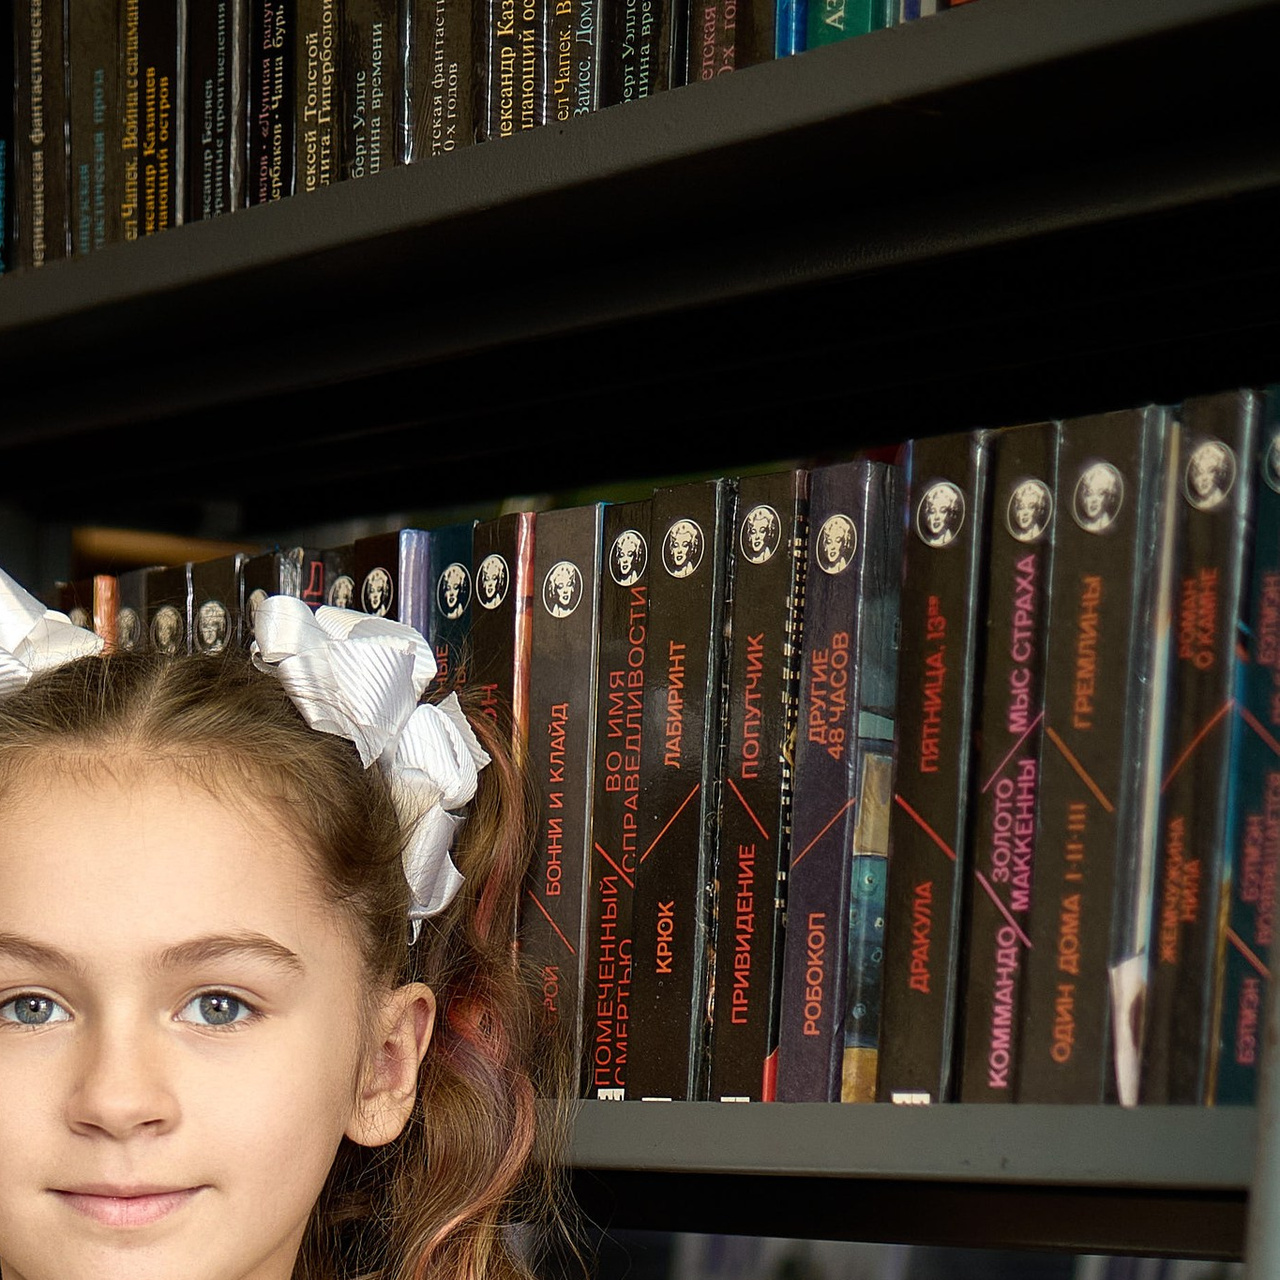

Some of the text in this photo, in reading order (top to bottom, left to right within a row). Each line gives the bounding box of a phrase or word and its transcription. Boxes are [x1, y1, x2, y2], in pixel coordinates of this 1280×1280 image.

[215, 3, 227, 133] произведения
[273, 4, 286, 109] Чаша бурь
[372, 22, 384, 110] времени
[554, 24, 572, 95] Чапек.
[575, 0, 594, 45] Дом
[121, 91, 140, 149] Война
[143, 66, 157, 156] Казанцев
[159, 75, 172, 142] остров
[201, 79, 213, 143] Беляев
[304, 32, 318, 122] Толстой
[353, 71, 366, 130] Уэллс
[446, 62, 458, 119] годов
[1009, 553, 1037, 733] МЫС СТРАХА
[1072, 574, 1103, 731] ГРЕМЛИНЫ
[1178, 577, 1197, 661] РОМАН
[1195, 566, 1219, 670] О КАМНЕ
[604, 670, 626, 792] ВО ИМЯ
[621, 585, 648, 873] СПРАВЕДЛИВОСТИ
[663, 639, 686, 770] ЛАБИРИНТ
[741, 633, 765, 779] ПОПУТЧИК
[808, 647, 830, 746] ДРУГИЕ
[828, 632, 851, 760] 48 ЧАСОВ
[547, 702, 570, 897] БОННИ И КЛАЙД
[992, 778, 1014, 884] ЗОЛОТО
[1013, 758, 1038, 912] МАККЕННЫ
[1159, 815, 1186, 965] ЖЕМЧУЖИНА
[1180, 859, 1202, 923] НИЛА
[1239, 814, 1264, 903] БЭТМЭН
[593, 875, 619, 1087] ПОМЕЧЕННЫЙ
[655, 900, 676, 975] КРЮК
[730, 843, 756, 1026] ПРИВИДЕНИЕ
[803, 912, 826, 1037] РОБОКОП
[908, 880, 934, 994] ДРАКУЛА
[1049, 894, 1082, 1064] ОДИН ДОМА
[615, 939, 632, 1087] СМЕРТЬЮ
[988, 924, 1018, 1089] КОММАНДО
[1235, 977, 1261, 1067] БЭТМЭН
